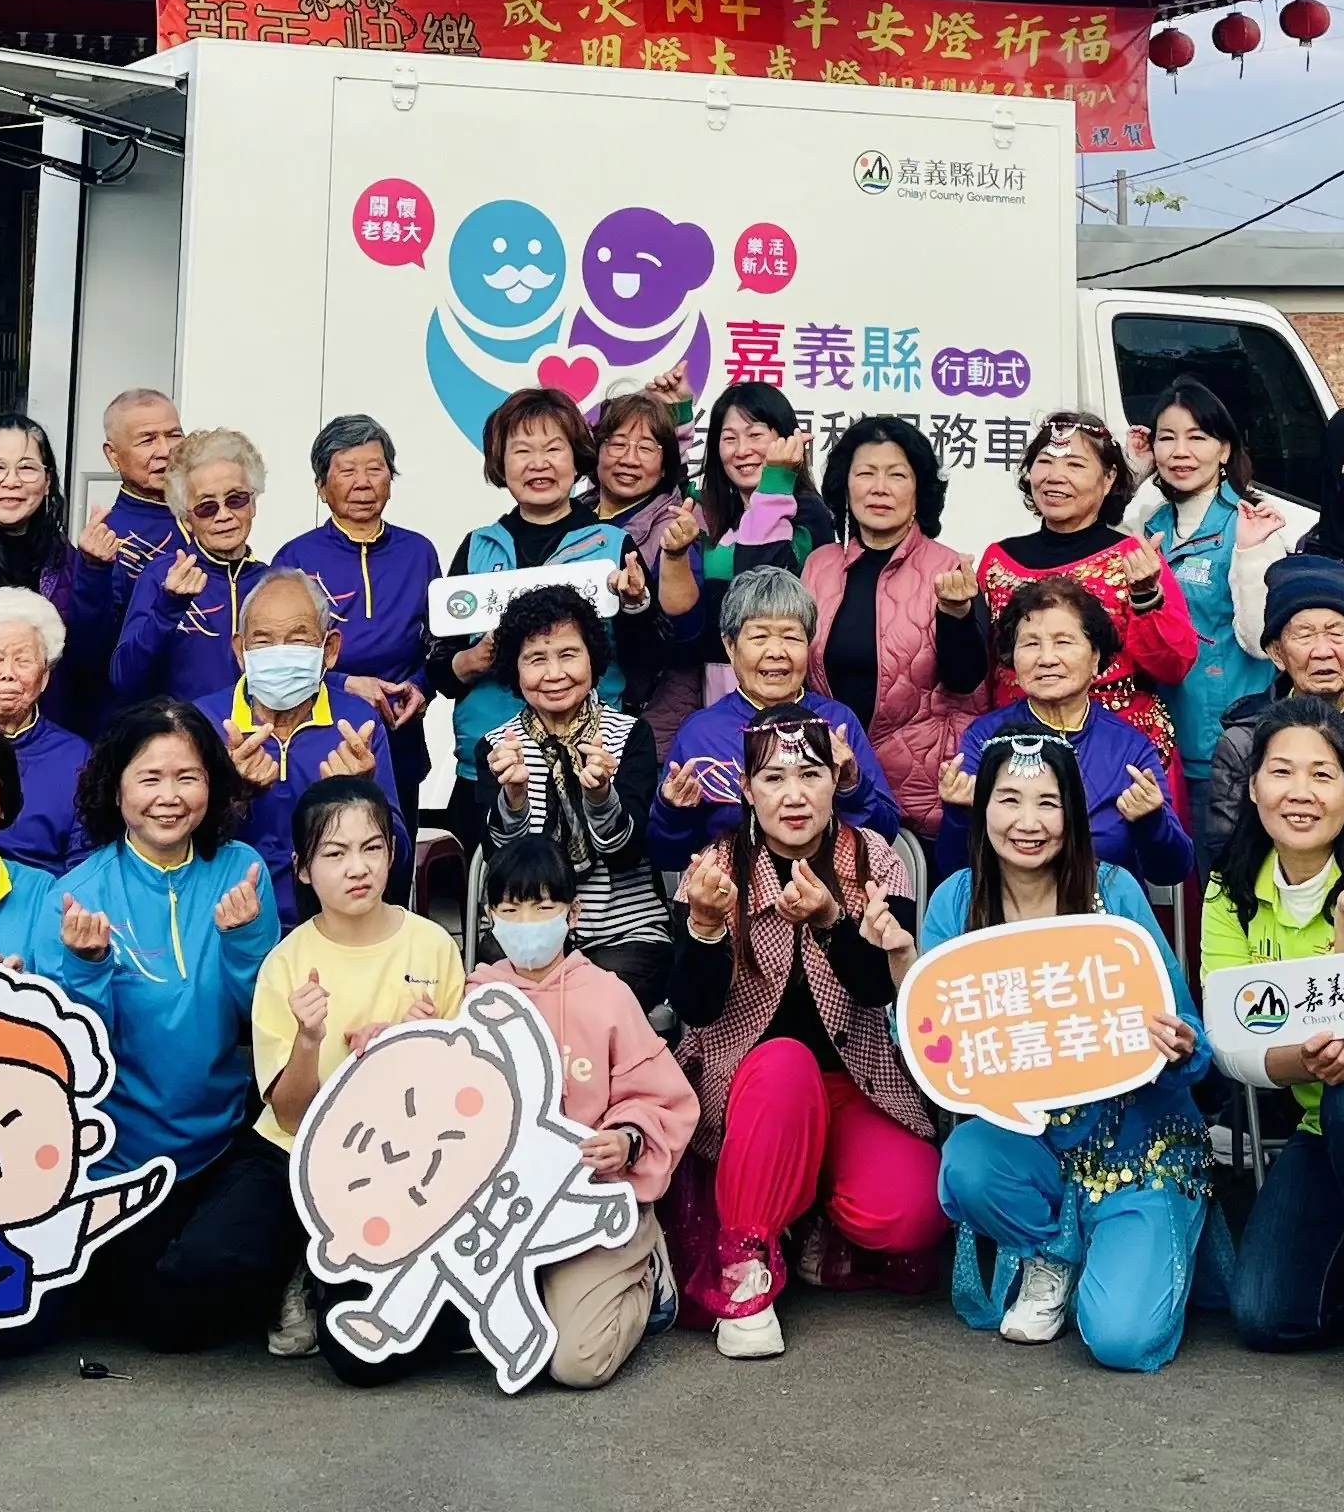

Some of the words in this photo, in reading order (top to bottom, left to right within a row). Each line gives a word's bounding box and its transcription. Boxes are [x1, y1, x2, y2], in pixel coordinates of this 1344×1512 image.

[897, 157, 1027, 191] 嘉義縣政府
[369, 195, 417, 219] 關懷
[897, 187, 927, 201] Chiayi
[929, 190, 965, 203] County
[967, 192, 1026, 204] Government
[361, 219, 422, 244] 老勢大
[747, 237, 784, 256] 樂活
[741, 256, 789, 276] 新人生
[724, 319, 923, 393] 嘉義縣
[937, 354, 1025, 389] 行動式
[936, 954, 1126, 1026] 活躍老化
[1302, 1010, 1337, 1025] Chiayi
[959, 1005, 1151, 1079] 抵嘉幸福
[563, 1045, 593, 1083] ie
